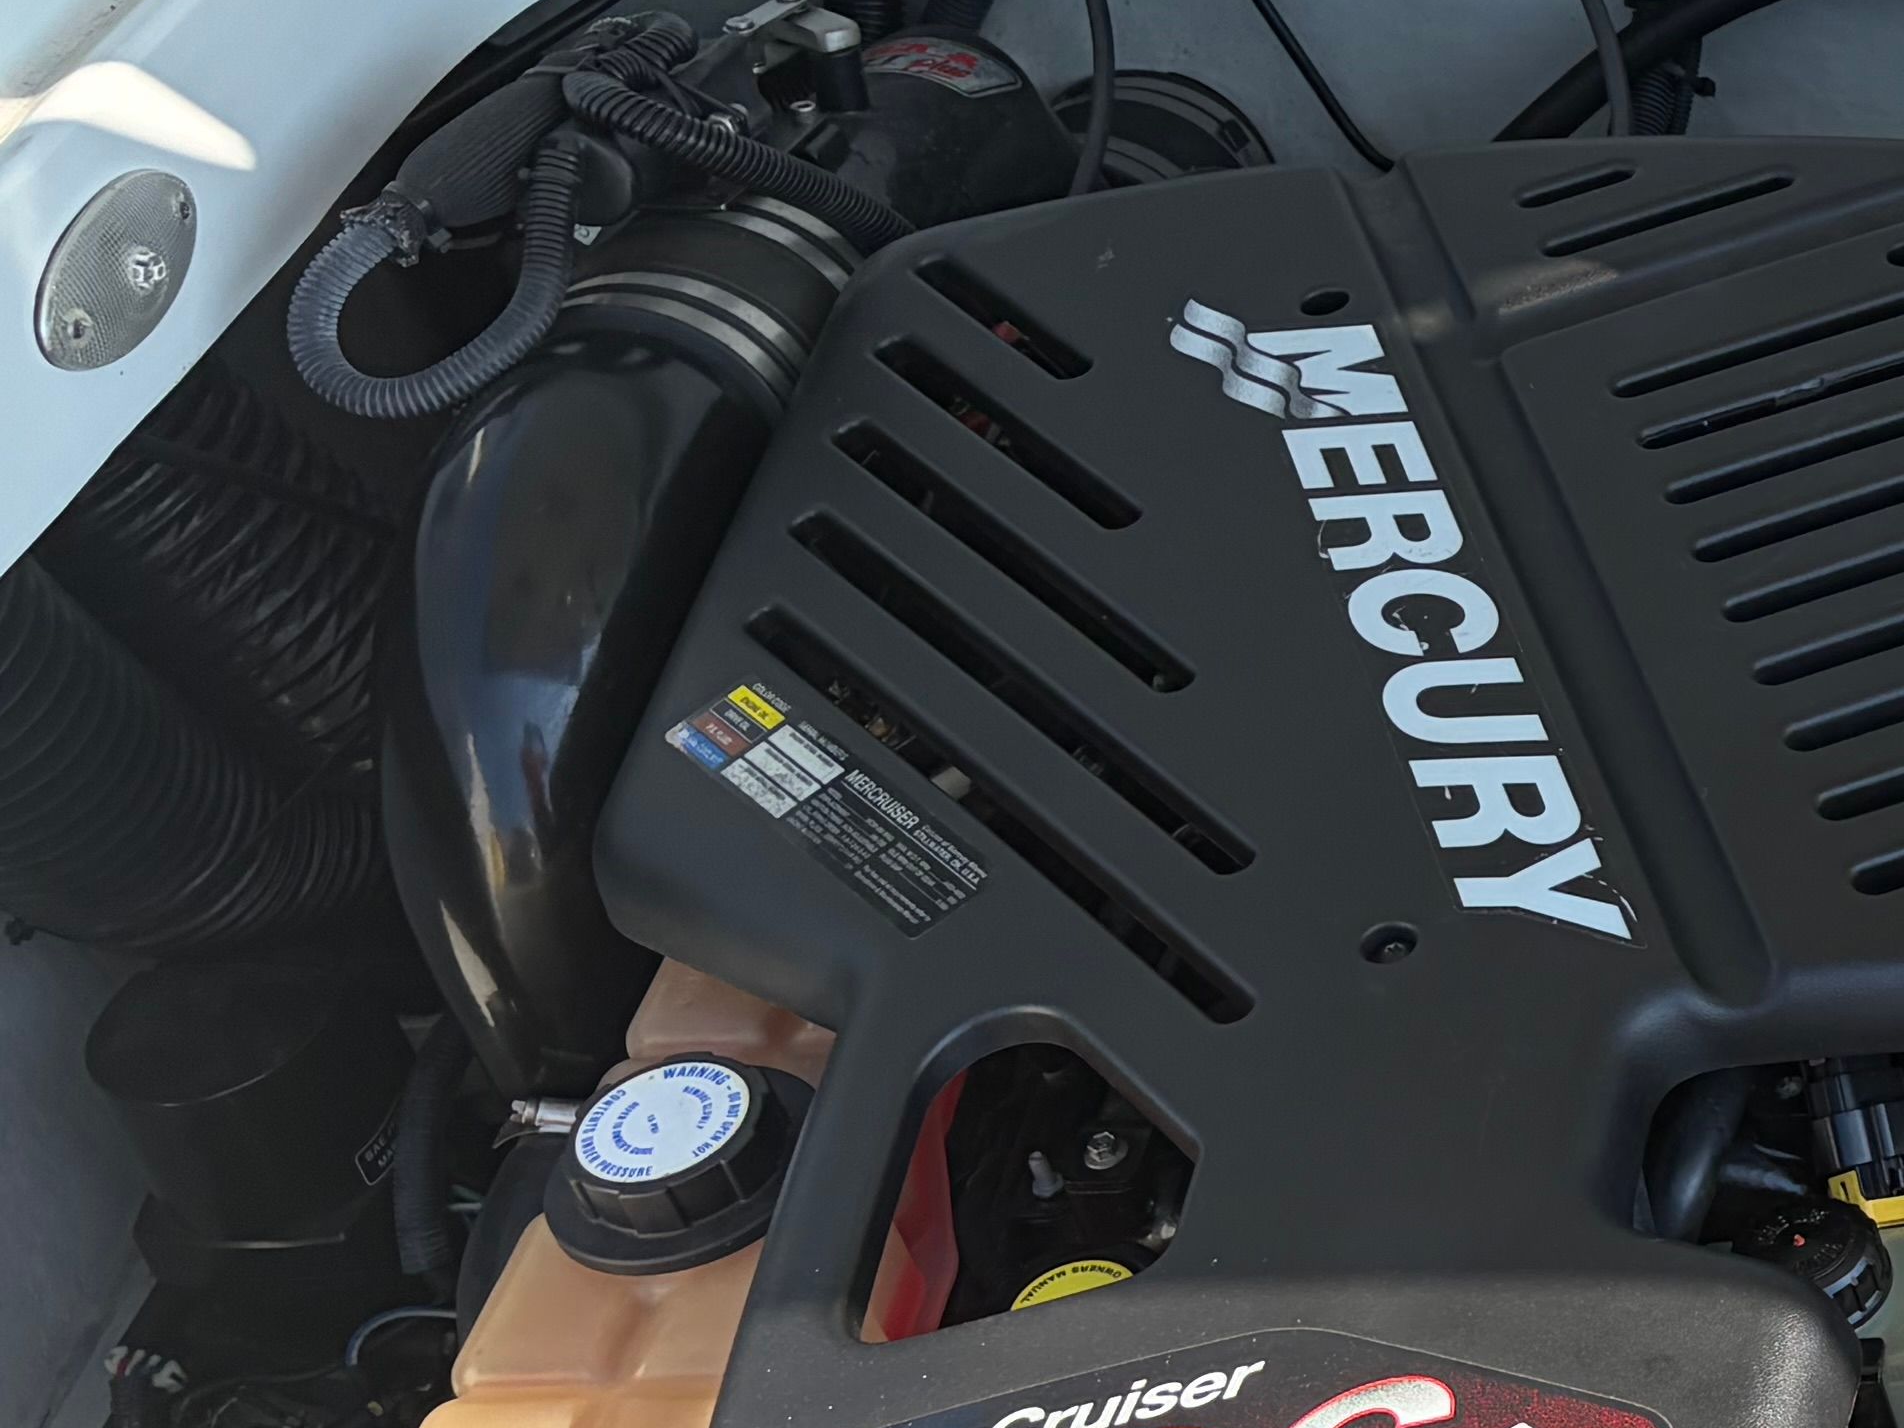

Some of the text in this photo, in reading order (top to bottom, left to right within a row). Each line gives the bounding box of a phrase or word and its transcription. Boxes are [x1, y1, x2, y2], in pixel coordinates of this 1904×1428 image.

[1170, 299, 1632, 940] MERCURY
[843, 767, 921, 830] MERCRUISER
[663, 1065, 731, 1085] WARNING
[581, 1089, 653, 1178] CONTENTS UNDER PRESSURE
[691, 1142, 713, 1158] HOT
[1019, 1264, 1122, 1304] OWNERS MANUAL
